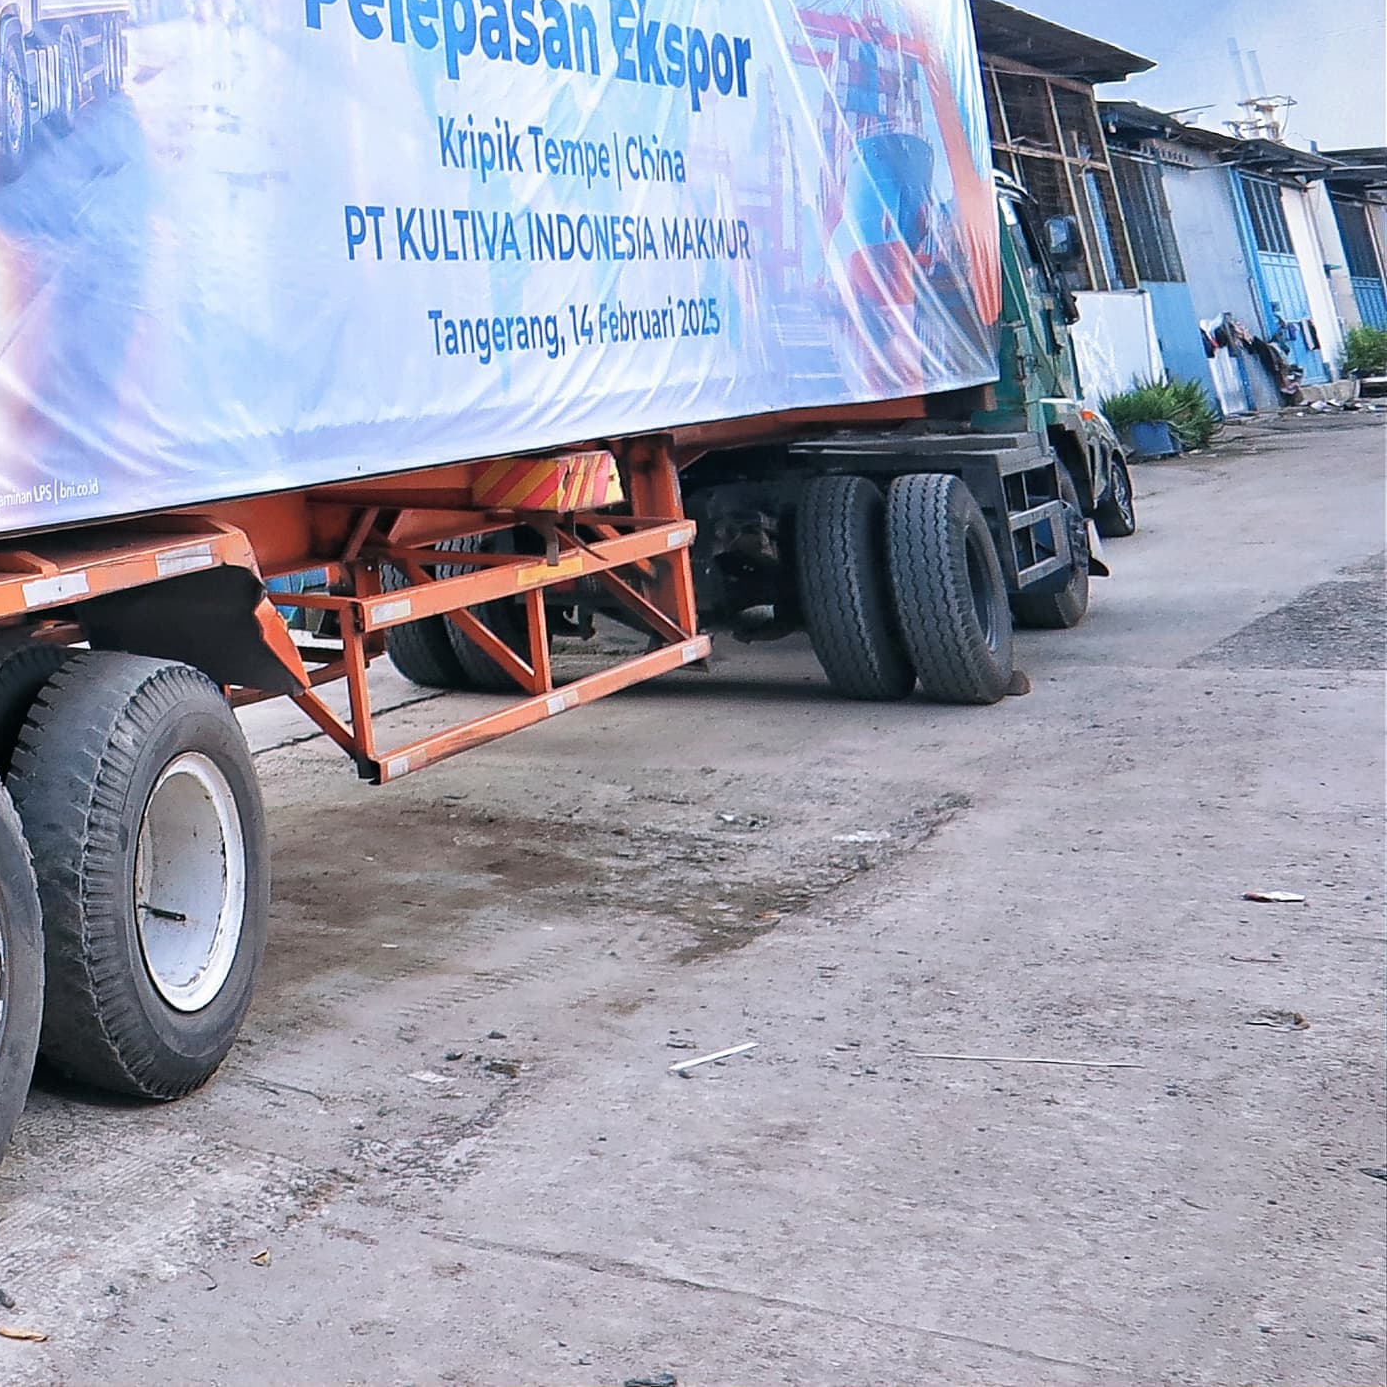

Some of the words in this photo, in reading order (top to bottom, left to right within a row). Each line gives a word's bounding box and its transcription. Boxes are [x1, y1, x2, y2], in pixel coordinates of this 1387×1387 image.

[438, 114, 524, 183] Kripik
[527, 126, 610, 189] Tempe
[627, 135, 686, 183] China
[344, 205, 385, 261] PT
[396, 207, 521, 261] KULTIVA
[526, 213, 658, 261] INDONESIA
[662, 217, 751, 261] MAKMUR
[427, 309, 565, 364] Tangerang,
[569, 303, 593, 345] 14
[598, 295, 675, 344] Februari
[681, 297, 720, 336] 2025
[34, 482, 52, 502] LPS
[60, 478, 99, 499] bni.co.id
